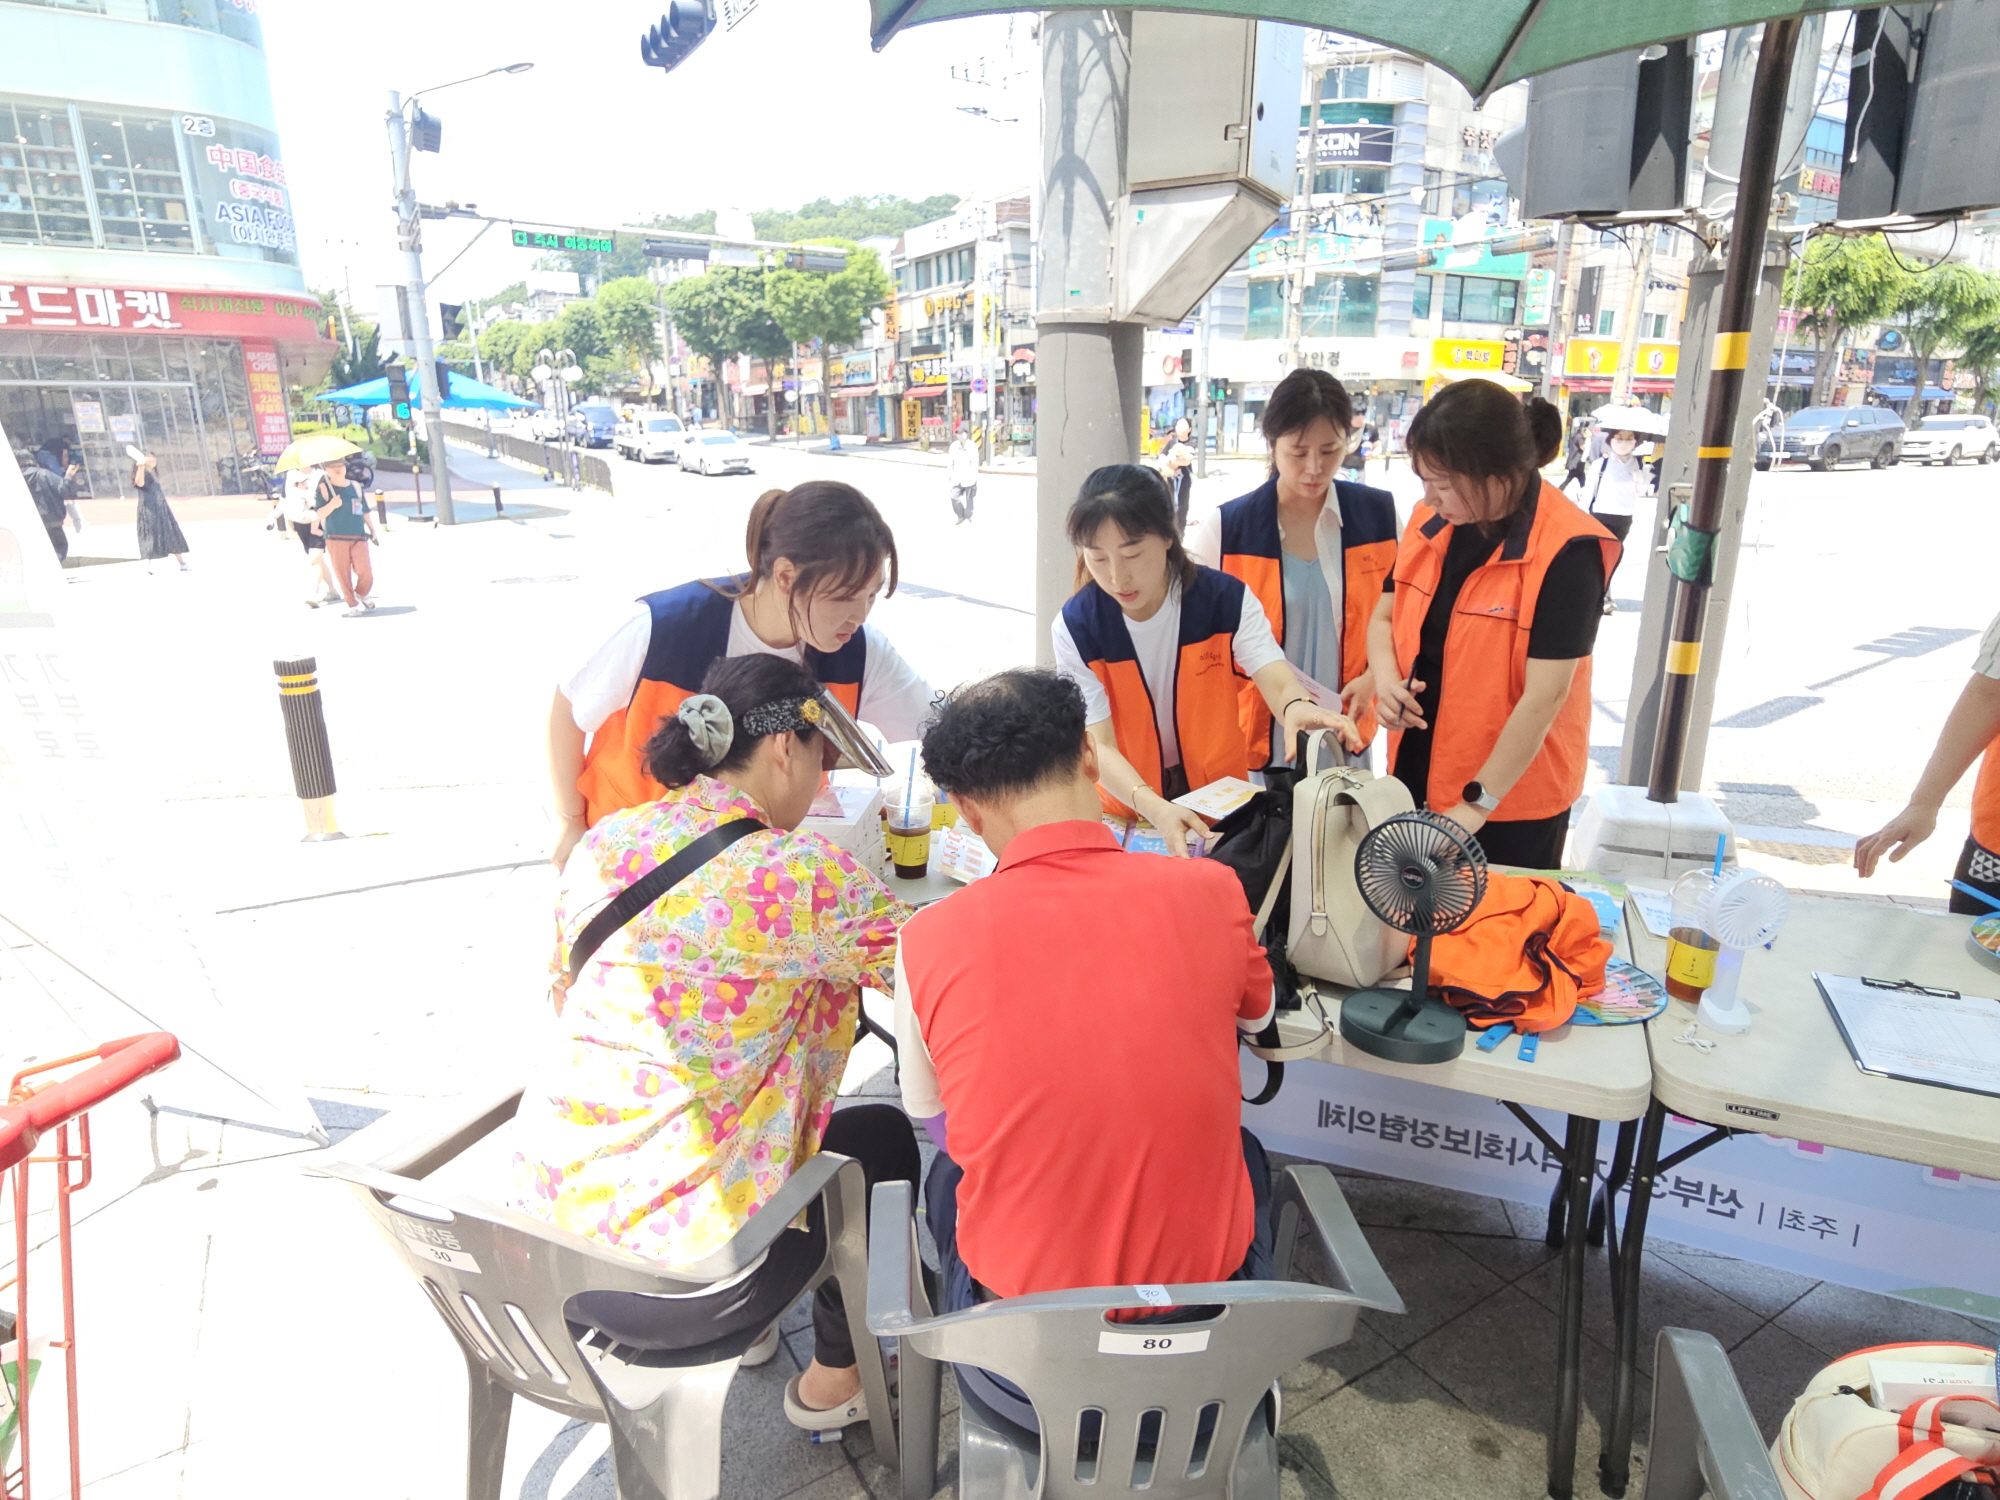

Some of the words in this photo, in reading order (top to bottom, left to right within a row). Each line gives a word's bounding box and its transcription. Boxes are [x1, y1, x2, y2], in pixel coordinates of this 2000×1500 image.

[183, 116, 214, 136] 2층
[217, 202, 264, 225] ASIA
[181, 296, 265, 315] 식자재전문
[430, 1248, 452, 1262] 30
[1143, 1338, 1172, 1350] 80
